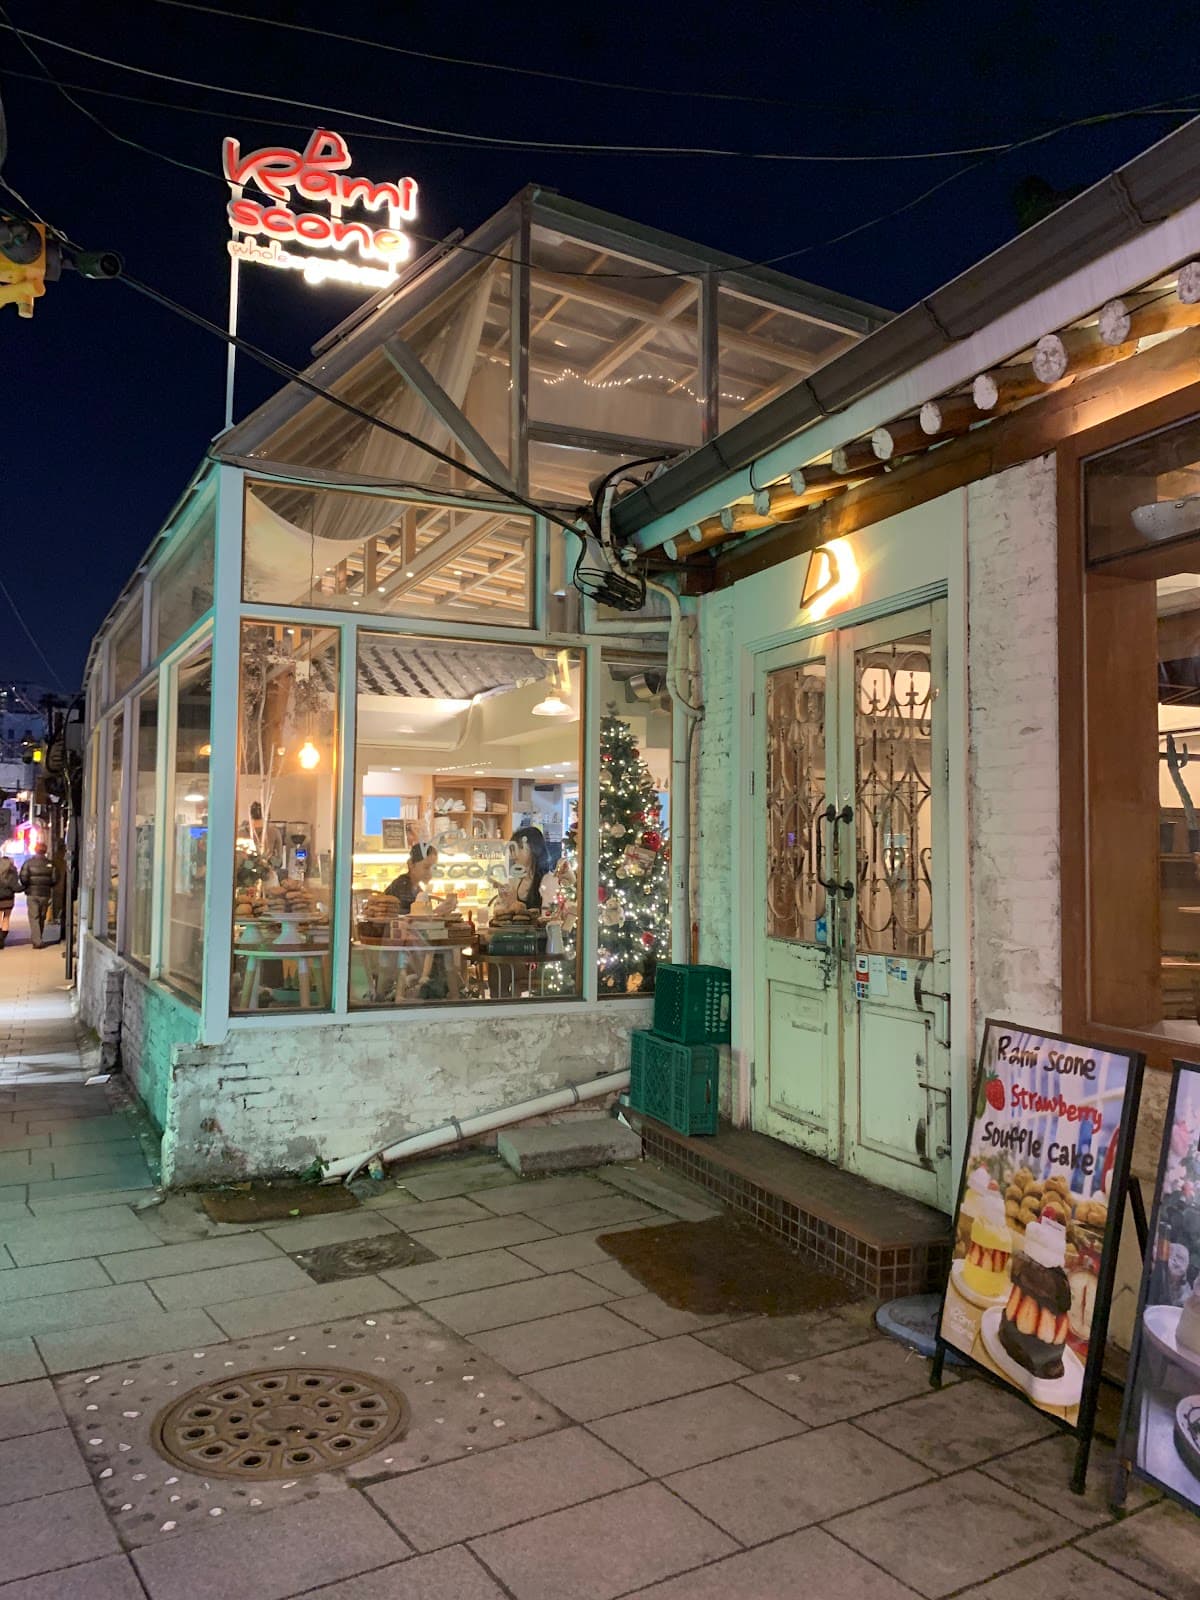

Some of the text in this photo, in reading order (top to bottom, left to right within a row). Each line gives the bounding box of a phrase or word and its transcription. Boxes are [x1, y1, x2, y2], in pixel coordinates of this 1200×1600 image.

[228, 199, 407, 258] scone
[997, 1035, 1040, 1067] Rami
[1010, 1084, 1103, 1134] Strawberry
[981, 1121, 1041, 1158] Souffle
